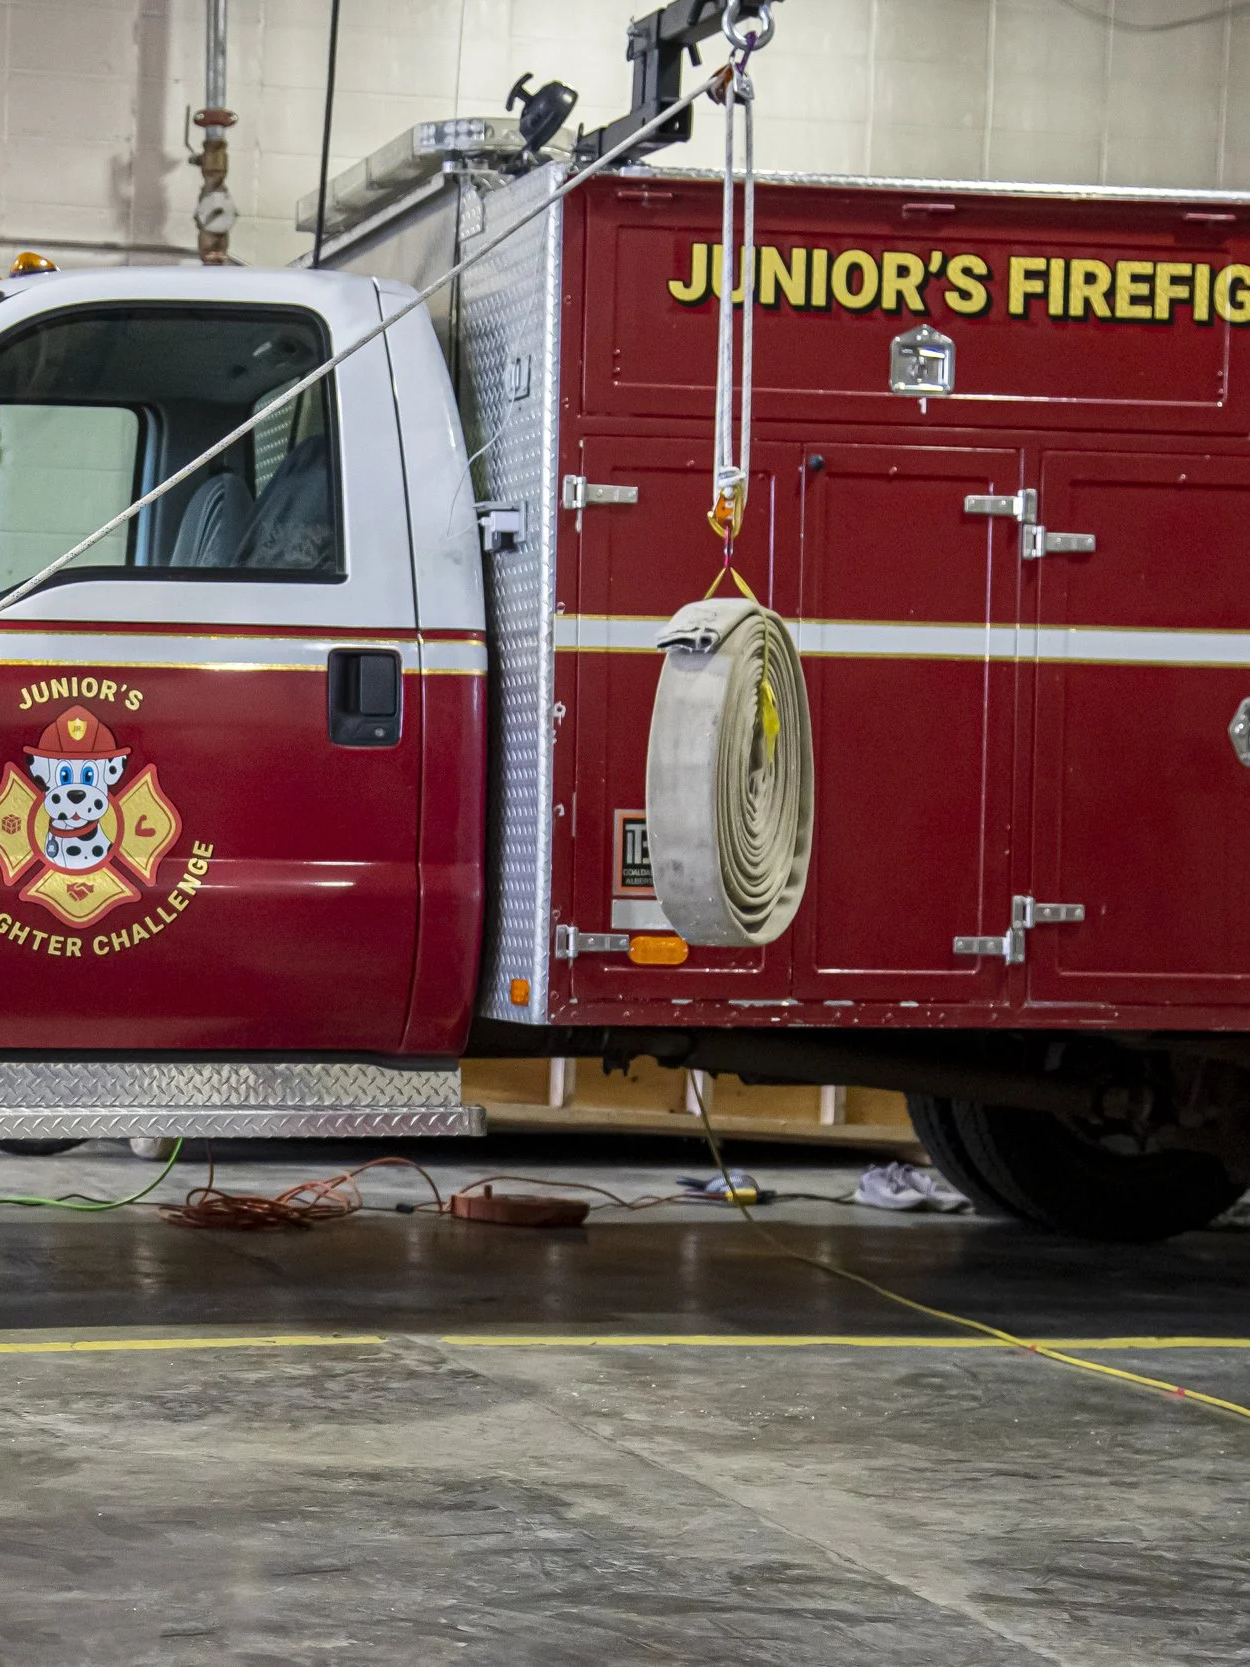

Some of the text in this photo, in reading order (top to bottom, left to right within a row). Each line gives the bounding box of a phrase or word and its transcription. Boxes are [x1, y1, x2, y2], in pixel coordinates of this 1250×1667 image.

[668, 242, 1250, 324] JUNIOR'S FIREFIG
[19, 676, 144, 711] JUNIOR'S
[92, 840, 214, 956] CHALLENGE
